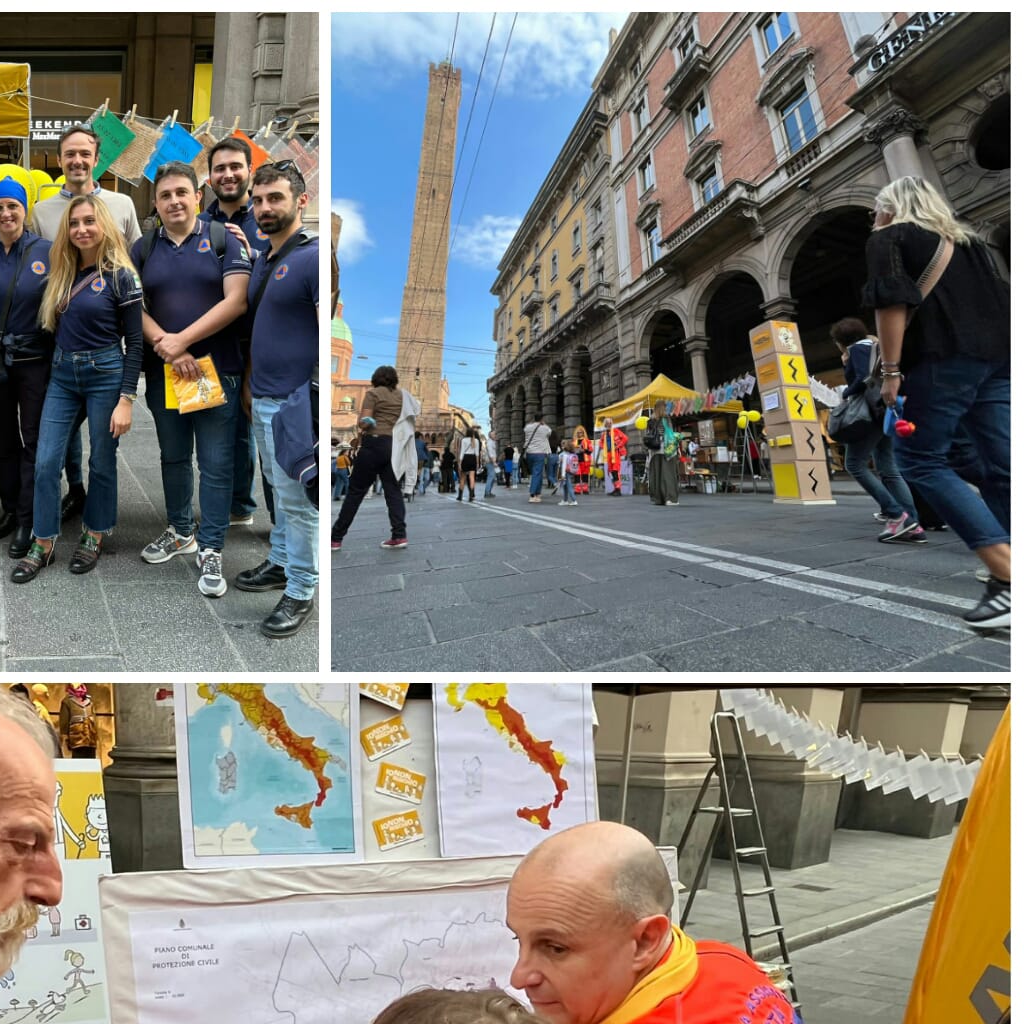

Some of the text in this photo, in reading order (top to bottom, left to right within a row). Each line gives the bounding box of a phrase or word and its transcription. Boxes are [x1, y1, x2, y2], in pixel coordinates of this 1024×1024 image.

[178, 944, 215, 953] COMUNALE
[152, 958, 219, 969] PROTEZIONE CIVILE
